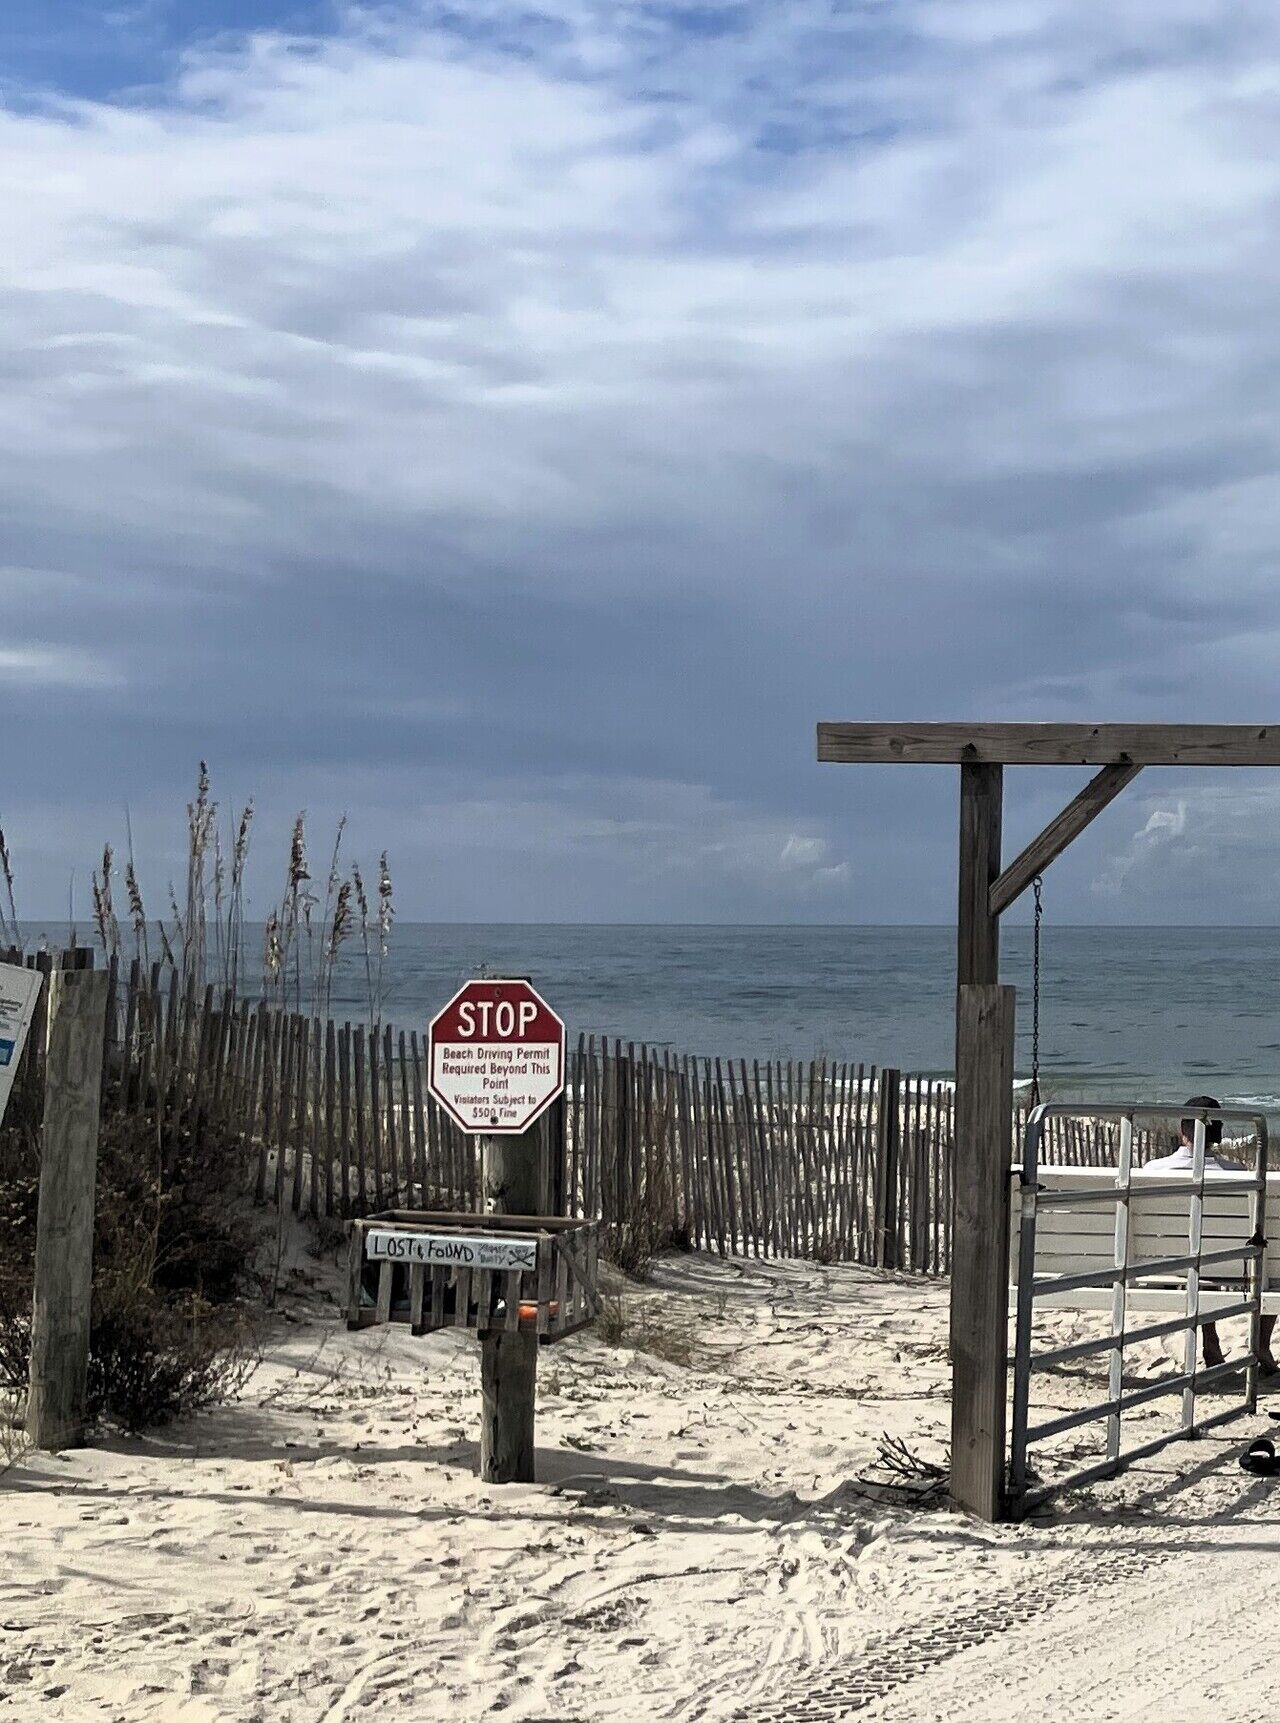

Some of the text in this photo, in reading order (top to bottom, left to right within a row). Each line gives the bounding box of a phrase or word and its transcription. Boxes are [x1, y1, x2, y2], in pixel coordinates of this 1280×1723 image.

[457, 1001, 538, 1037] STOP
[443, 1048, 550, 1062] Beach Driving Permit
[442, 1063, 550, 1076] Required Beyond This
[482, 1078, 509, 1089] Point
[454, 1094, 537, 1107] Violators Subject to
[472, 1107, 517, 1118] $500 Fine
[374, 1236, 416, 1257] LOST
[428, 1239, 474, 1262] FOUND
